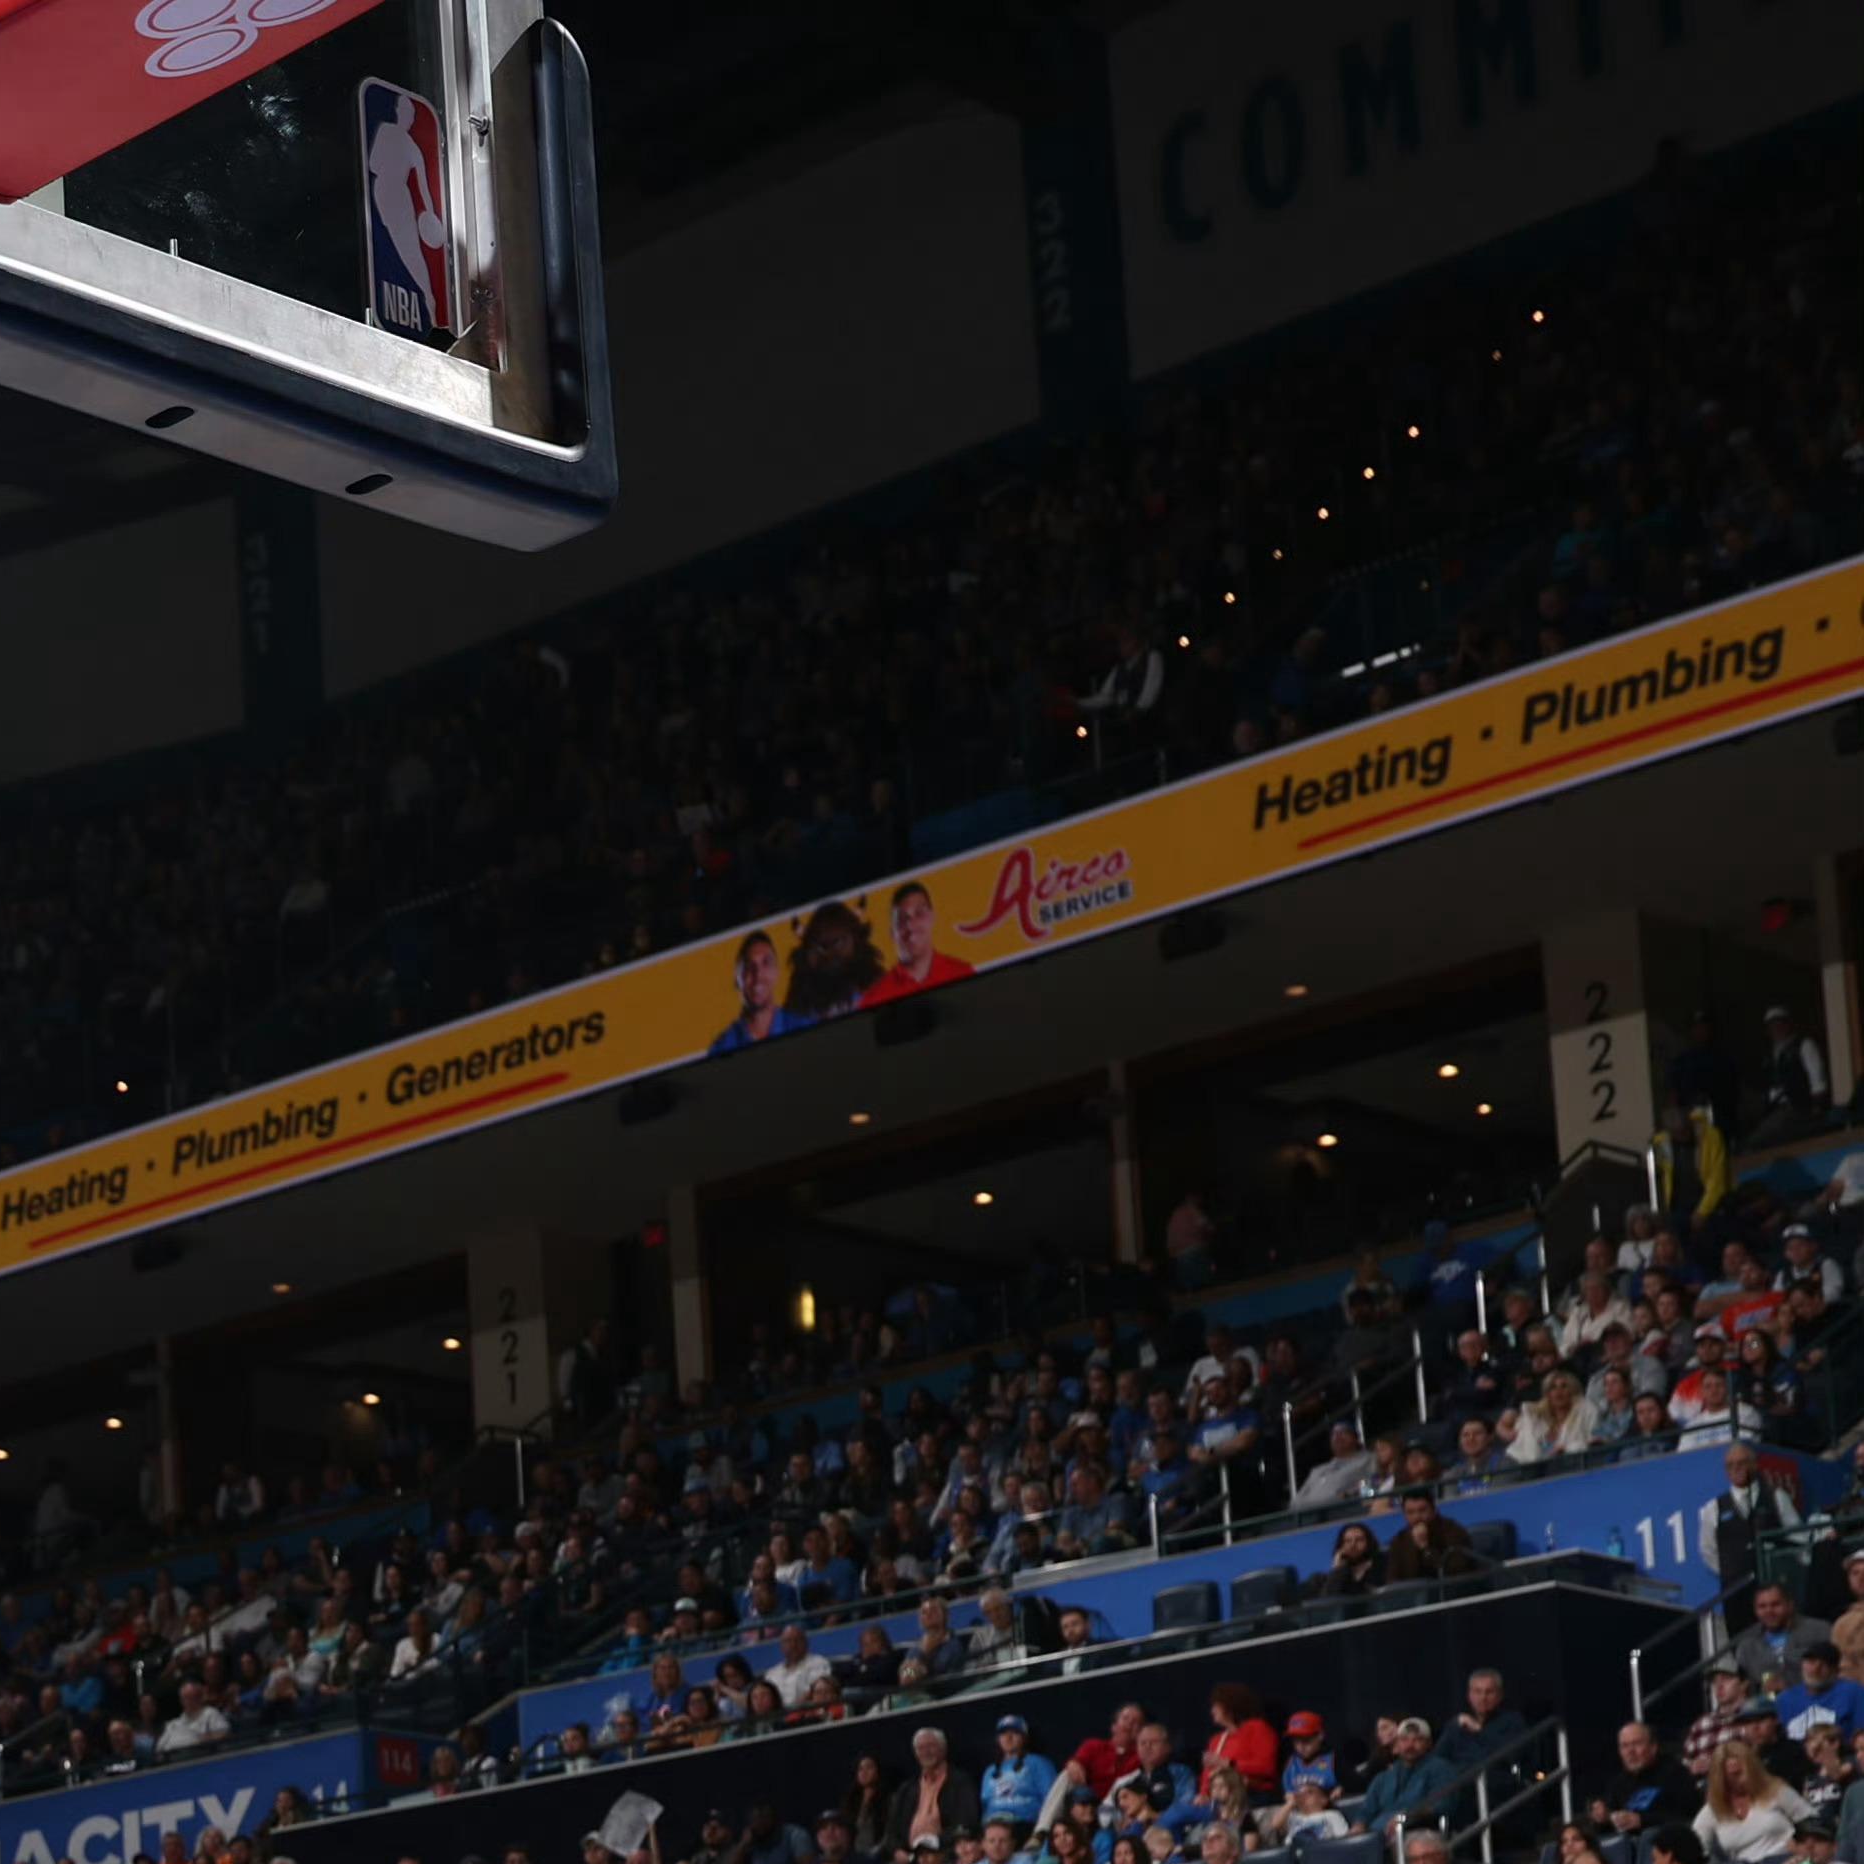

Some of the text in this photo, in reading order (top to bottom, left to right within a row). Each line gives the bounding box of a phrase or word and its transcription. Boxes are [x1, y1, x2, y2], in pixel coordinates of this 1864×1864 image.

[383, 280, 422, 333] NBA
[1252, 624, 1787, 832] Heating Plumbing
[955, 845, 1132, 940] Airco
[1038, 878, 1134, 926] SERVICE
[1586, 980, 1618, 1124] 222
[0, 1007, 607, 1232] Heating Plumbing Generators
[498, 1285, 518, 1403] 221
[380, 1747, 414, 1777] 114
